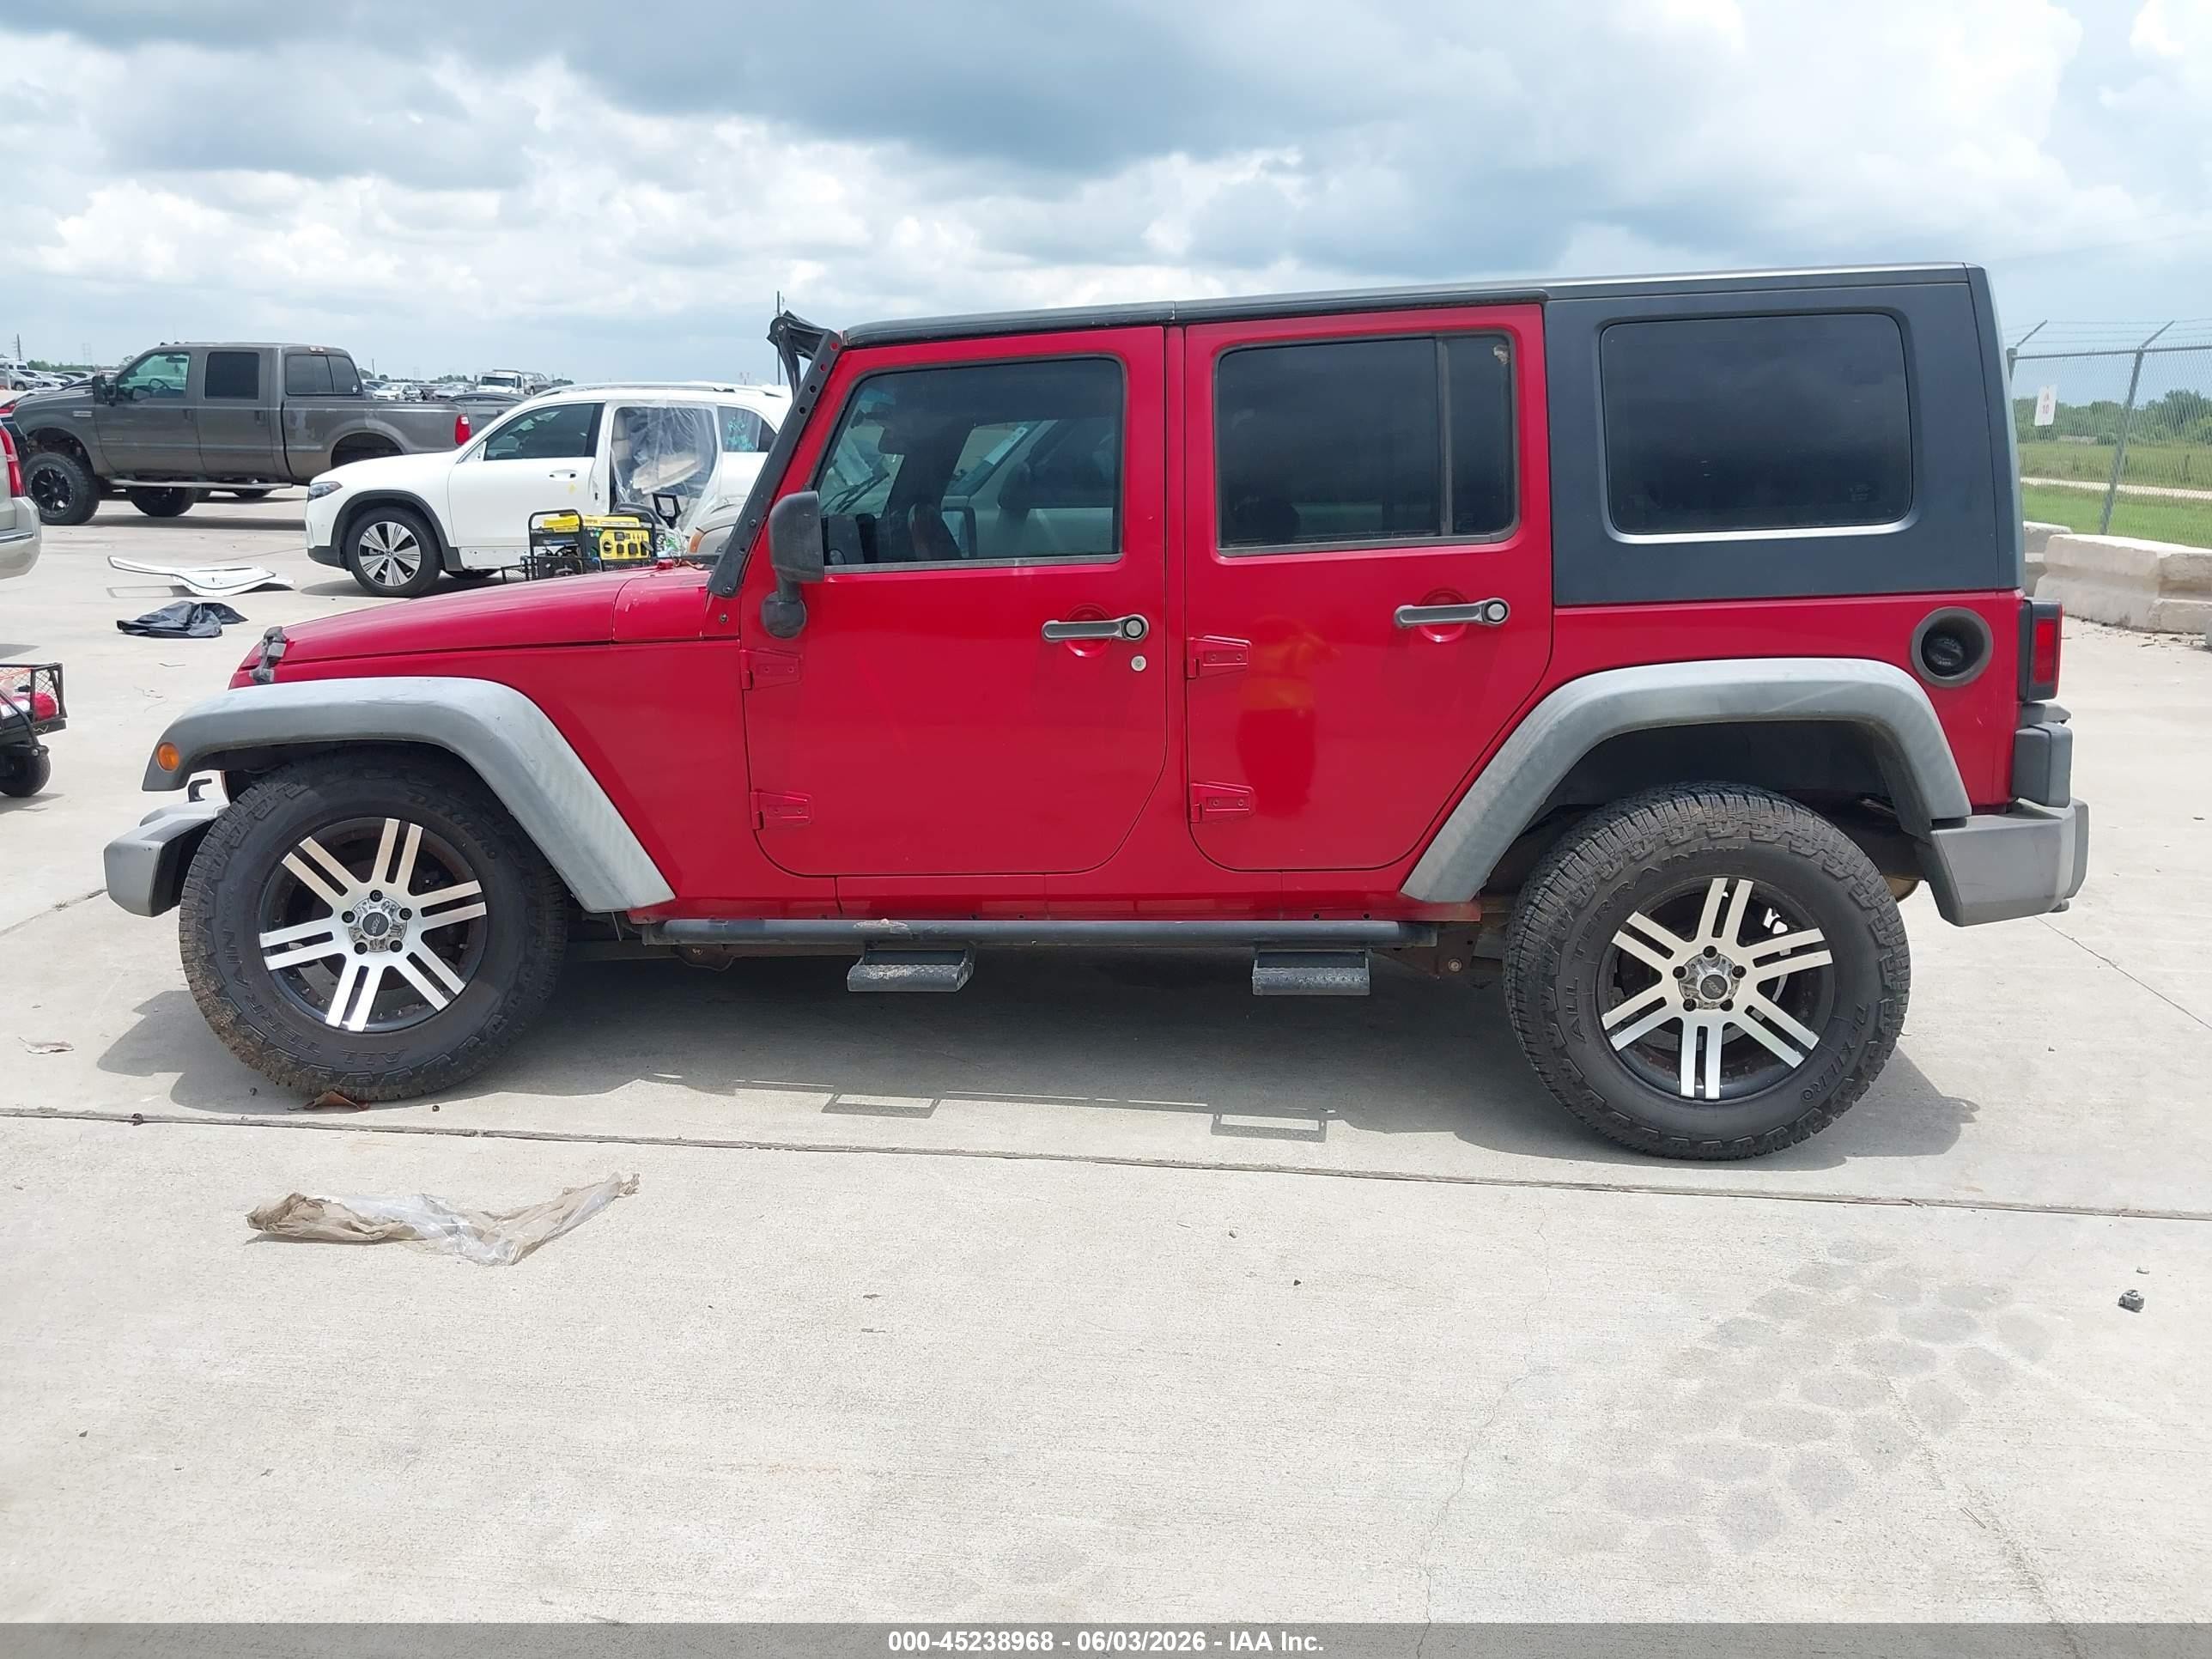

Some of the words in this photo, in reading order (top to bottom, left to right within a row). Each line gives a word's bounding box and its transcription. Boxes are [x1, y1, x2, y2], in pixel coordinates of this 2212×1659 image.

[222, 926, 324, 1057] TERRAIN
[1565, 974, 1587, 1043] ALL
[337, 1048, 408, 1066] ALL
